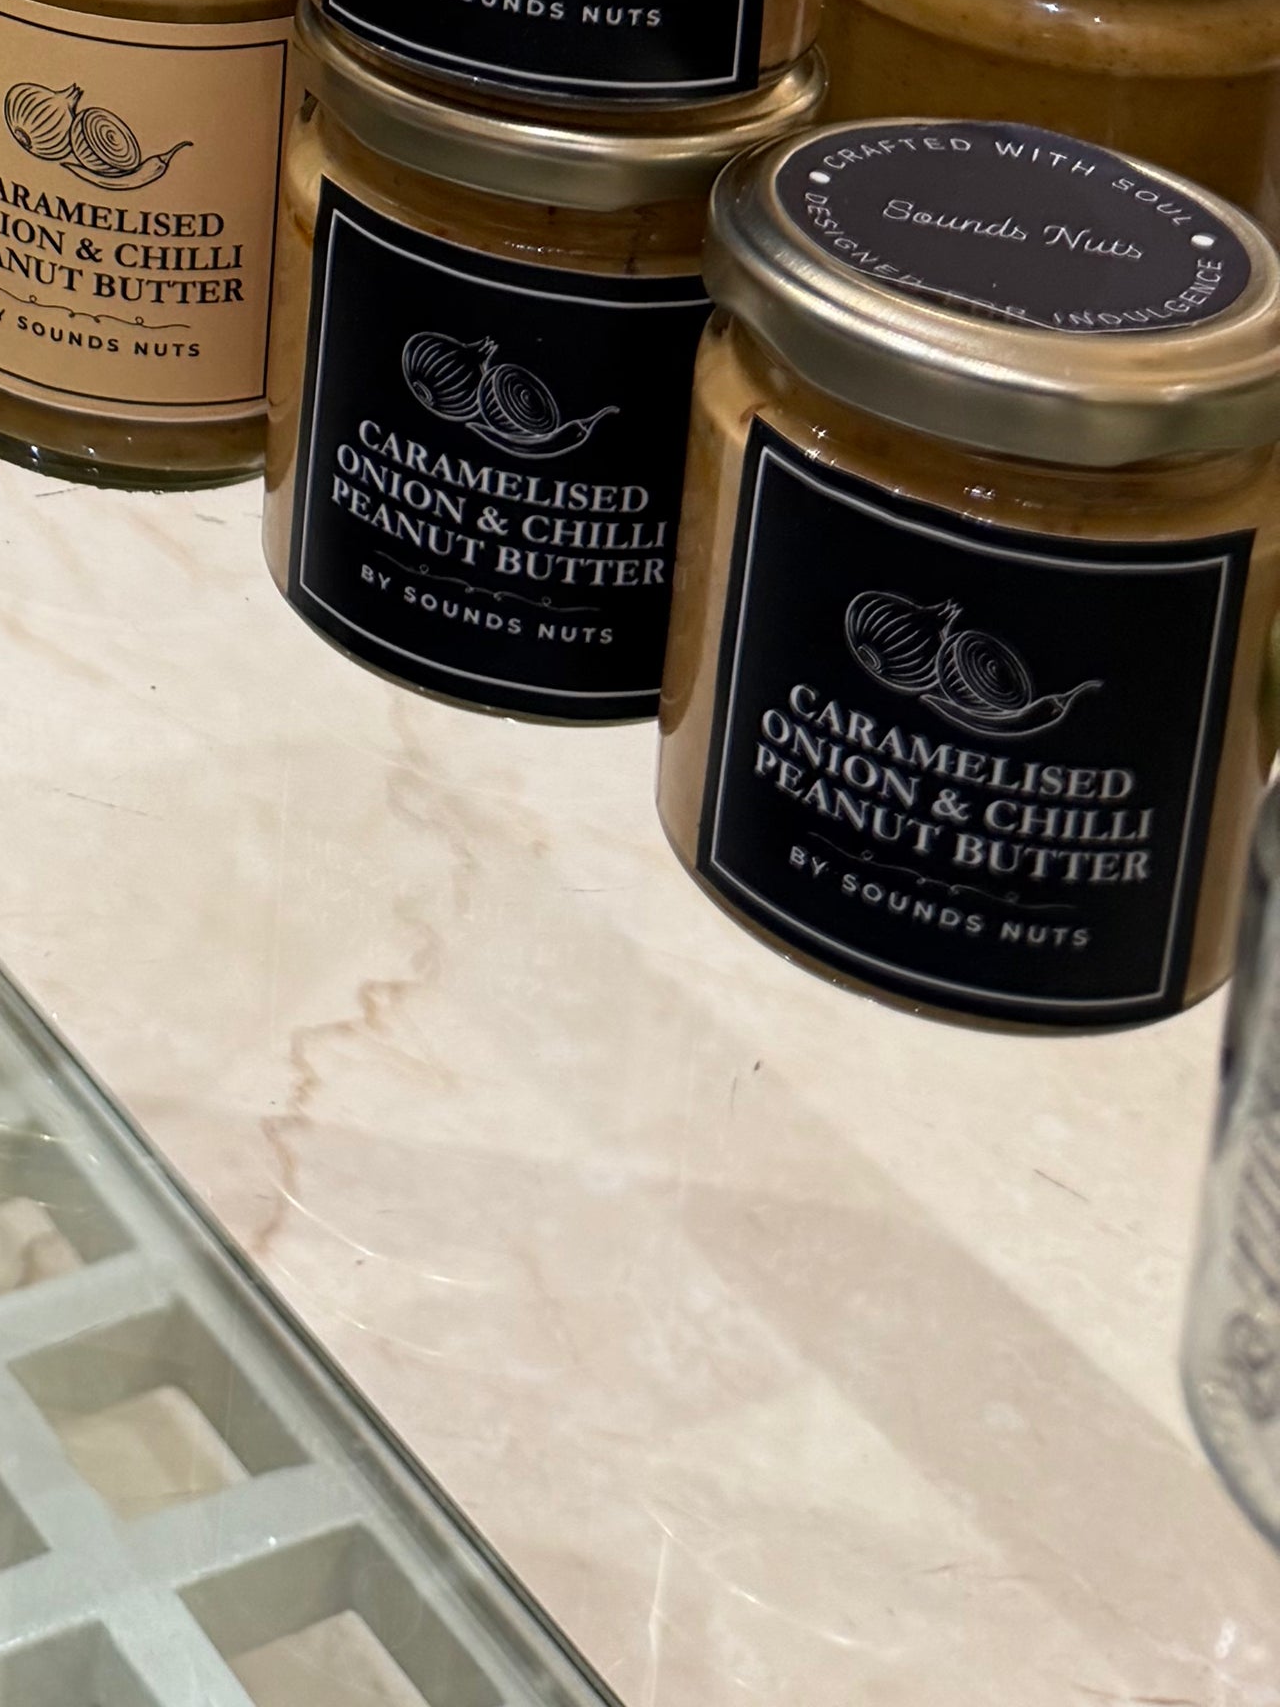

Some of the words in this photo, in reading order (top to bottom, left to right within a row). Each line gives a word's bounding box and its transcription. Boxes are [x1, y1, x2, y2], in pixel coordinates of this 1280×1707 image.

[581, 5, 664, 27] NUTS
[823, 137, 972, 170] CRAFTED
[994, 140, 1096, 178] WITH
[1111, 177, 1192, 227] SOUL
[75, 237, 103, 263] &
[114, 243, 243, 271] CHILLI
[882, 198, 1028, 242] Sounds
[1043, 223, 1143, 259] Nuts
[92, 272, 245, 304] BUTTER
[1053, 257, 1223, 325] INDULGENCE
[17, 315, 119, 352] SOUNDS
[134, 342, 201, 357] NUTS
[337, 444, 466, 523] ONION
[476, 506, 509, 536] &
[522, 514, 668, 550] CHILLI
[358, 419, 649, 513] CARAMELISED
[332, 474, 485, 566] PEANUT
[495, 545, 666, 587] BUTTER
[360, 564, 391, 590] BY
[403, 586, 522, 634] SOUNDS
[538, 623, 613, 644] NUTS
[761, 708, 920, 808] ONION
[931, 788, 970, 822] &
[984, 799, 1155, 841] CHILLI
[789, 683, 1134, 800] CARAMELISED
[755, 742, 941, 855] PEANUT
[952, 832, 1151, 883] BUTTER
[789, 844, 828, 877] BY
[842, 873, 984, 934] SOUNDS
[1000, 921, 1090, 947] NUTS
